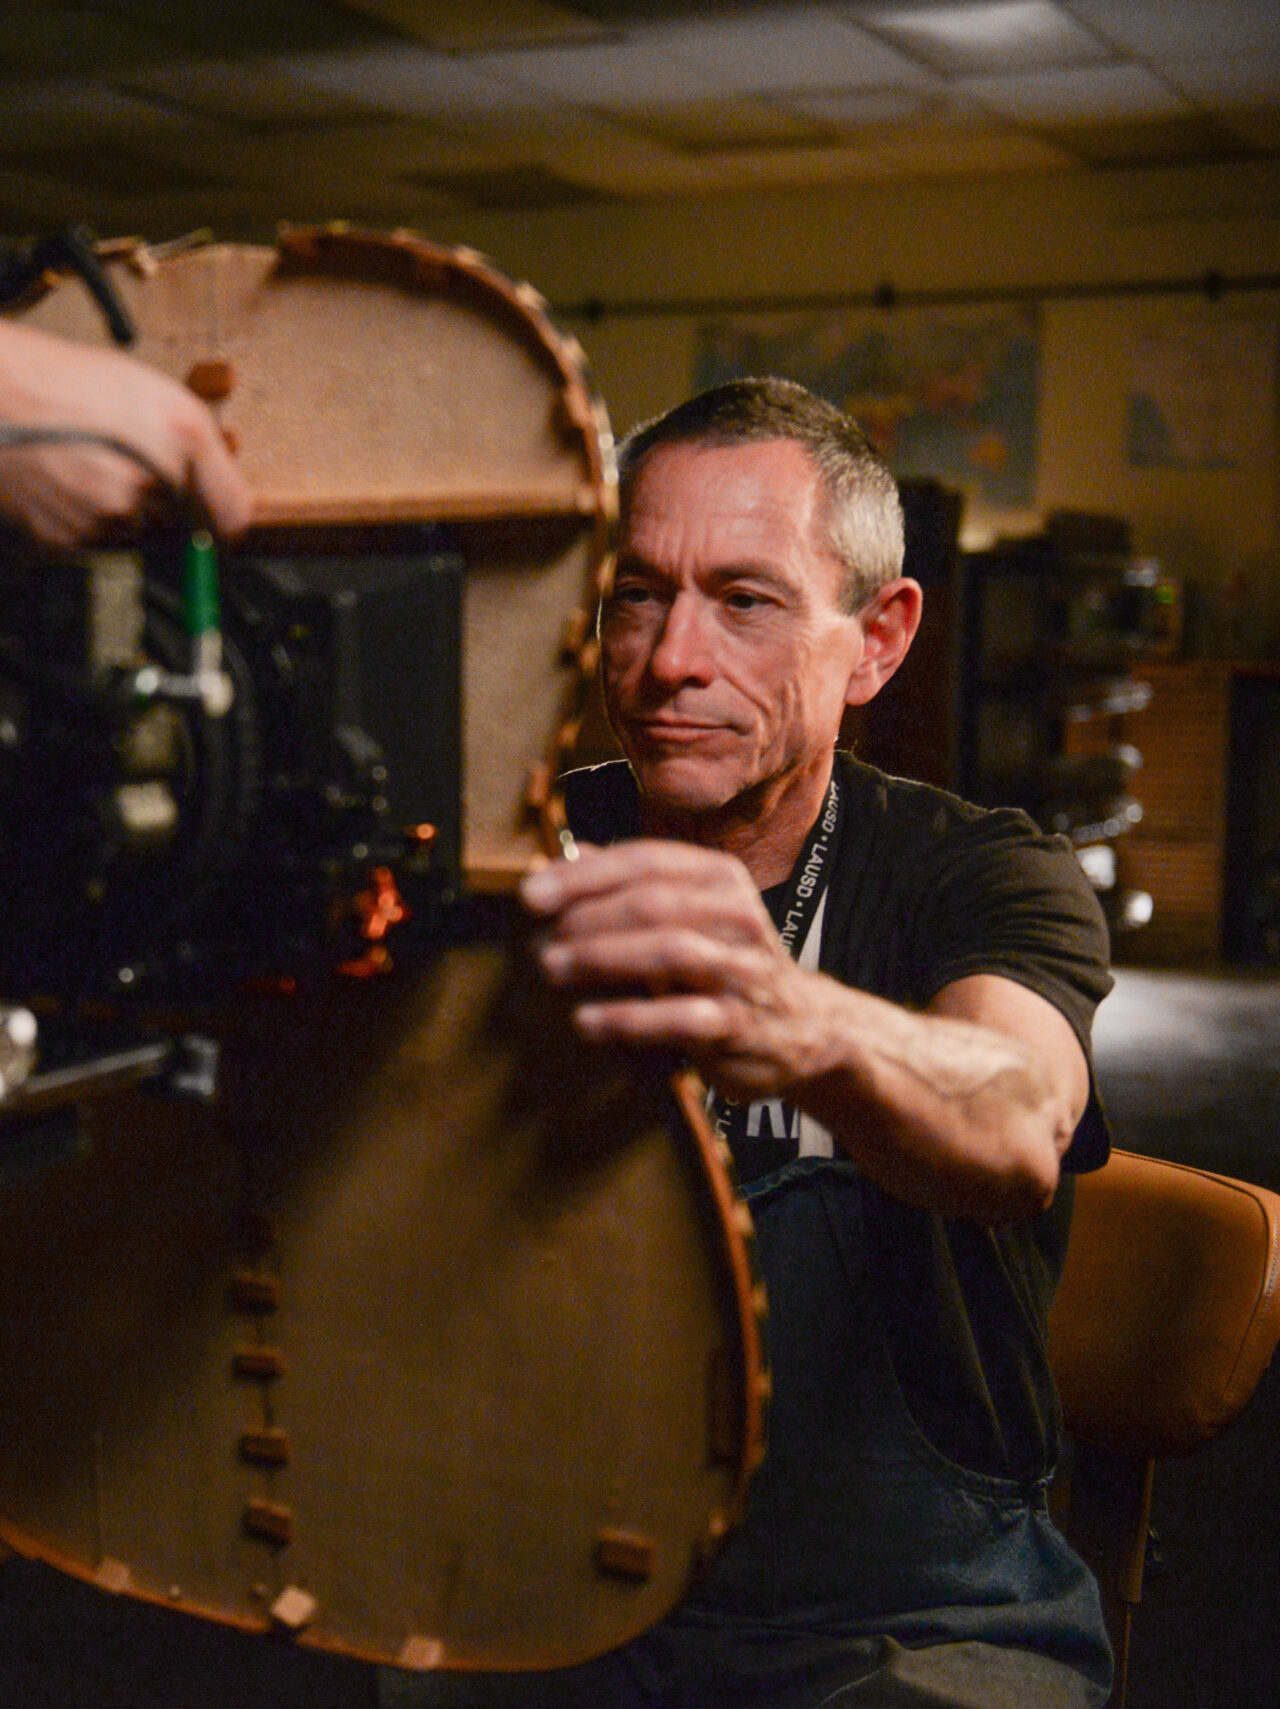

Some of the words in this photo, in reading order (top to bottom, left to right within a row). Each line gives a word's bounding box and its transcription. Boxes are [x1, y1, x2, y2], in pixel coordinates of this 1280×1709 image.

[821, 779, 840, 834] LAUSD
[796, 842, 828, 899] LAUSD
[778, 909, 804, 952] LAU
